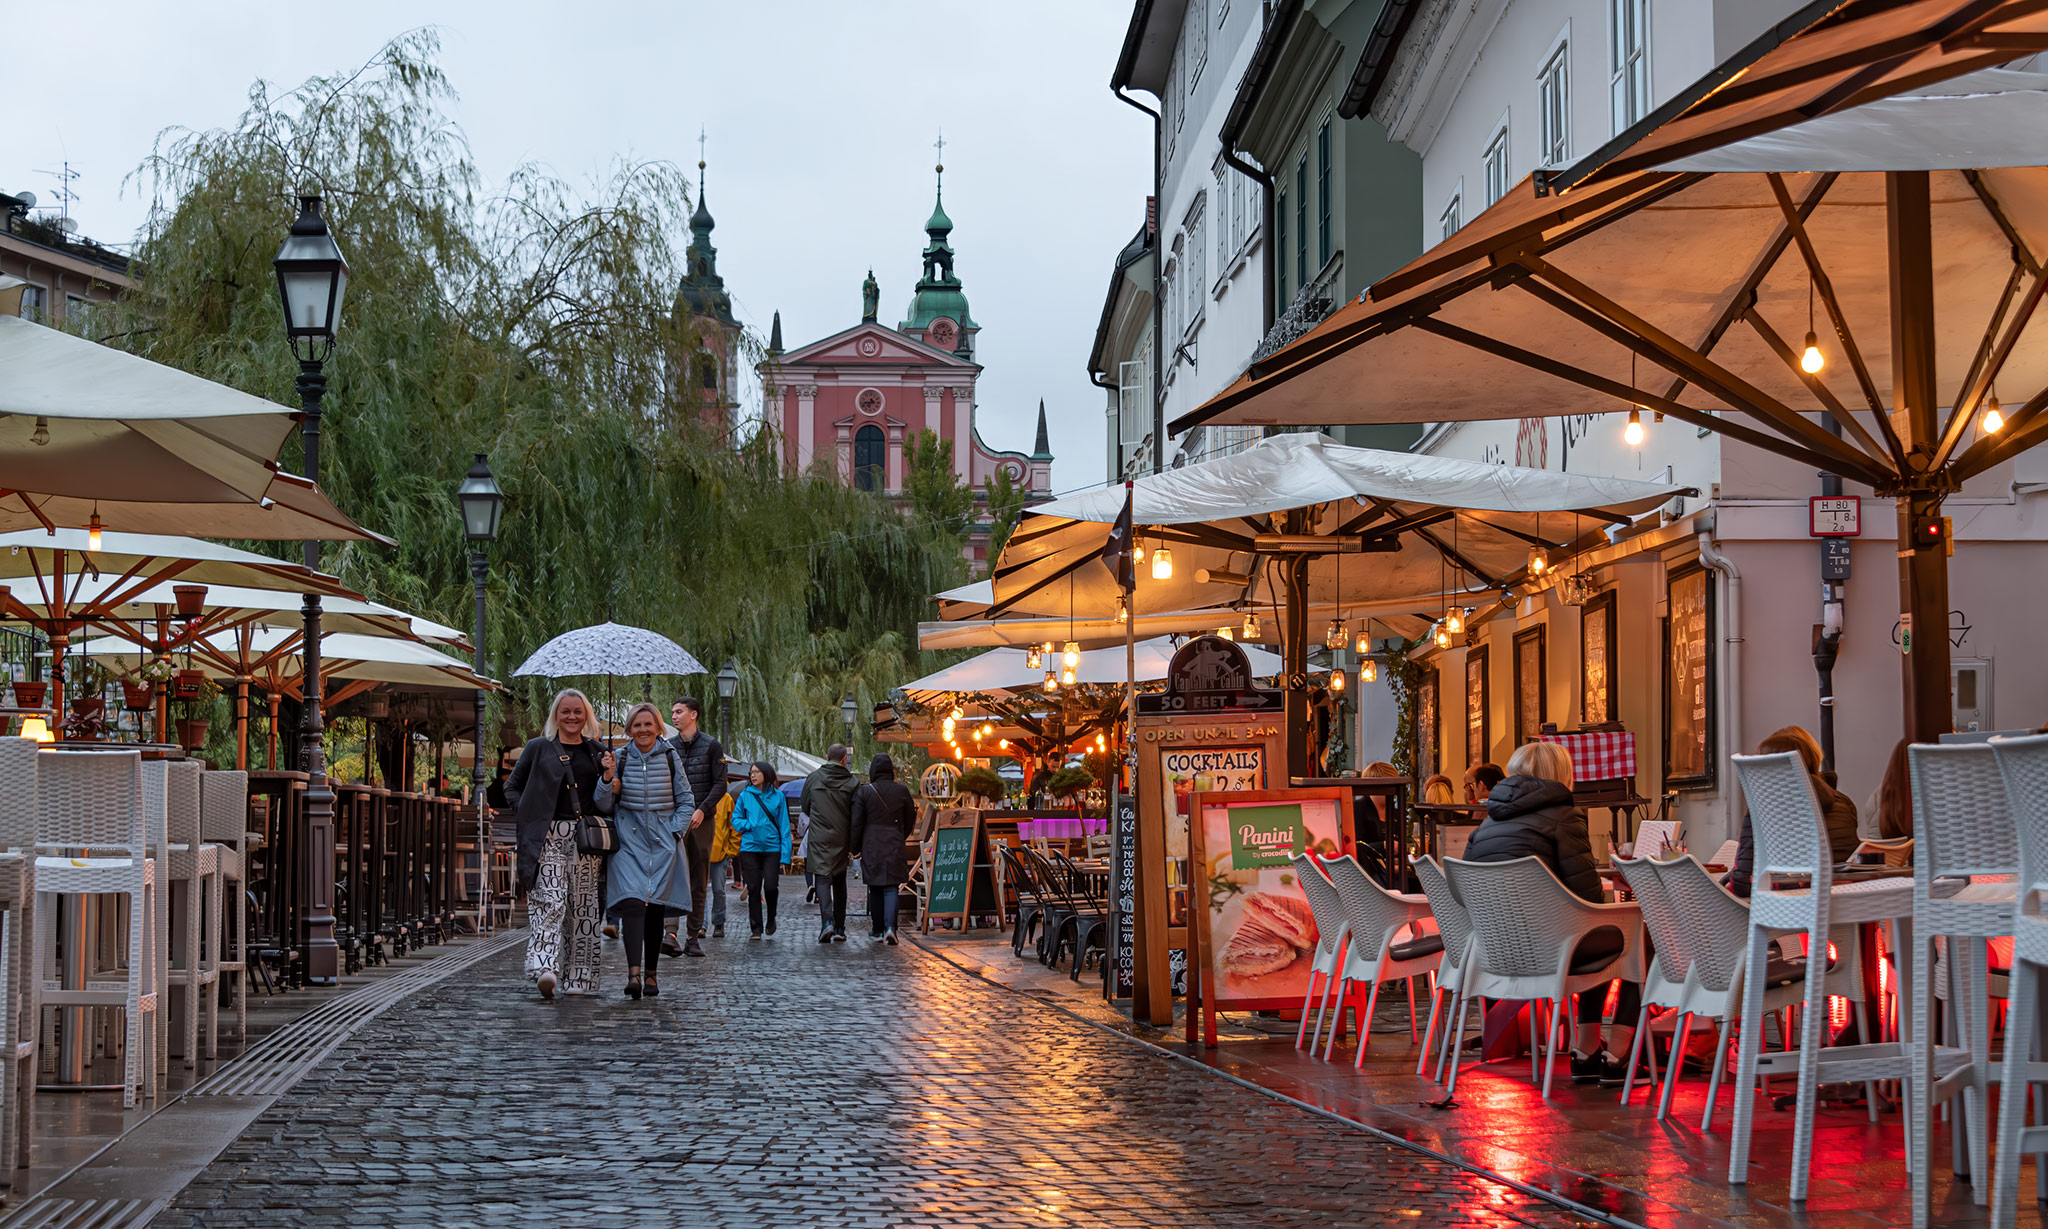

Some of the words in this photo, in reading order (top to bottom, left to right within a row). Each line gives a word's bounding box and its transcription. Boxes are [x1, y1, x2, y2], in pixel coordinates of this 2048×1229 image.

[1821, 501, 1829, 510] H
[1835, 500, 1848, 510] 80
[1829, 544, 1837, 554] Z
[1161, 696, 1186, 711] 50
[1193, 695, 1228, 709] FEET
[1144, 728, 1185, 742] OPEN
[1246, 725, 1279, 739] 3AM
[1167, 751, 1259, 773] COCKTAILS
[1216, 775, 1229, 791] 2
[1232, 776, 1246, 791] OR
[1247, 773, 1256, 790] 1
[1238, 823, 1294, 846] Panini
[1252, 851, 1260, 859] by
